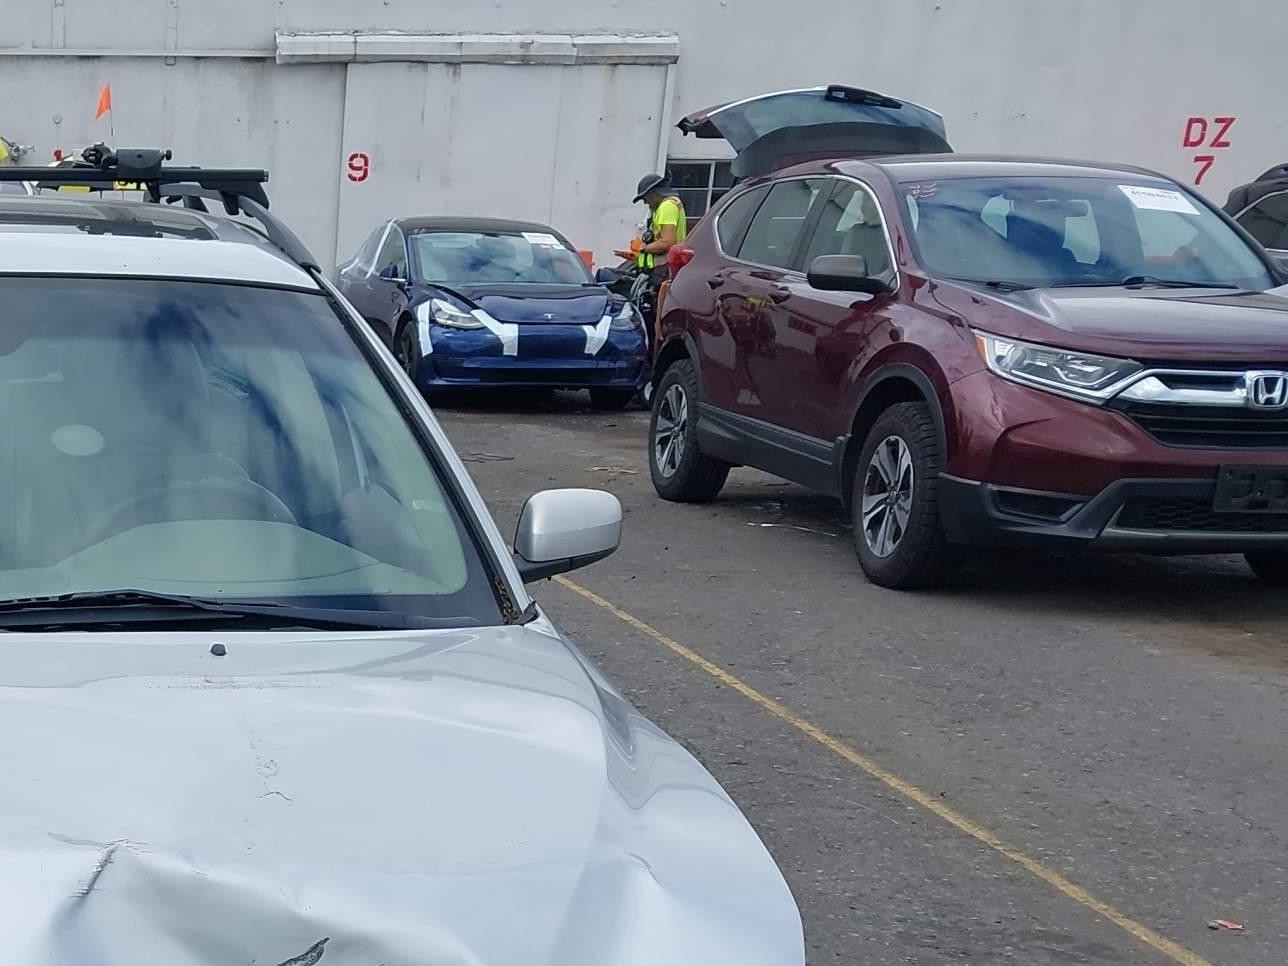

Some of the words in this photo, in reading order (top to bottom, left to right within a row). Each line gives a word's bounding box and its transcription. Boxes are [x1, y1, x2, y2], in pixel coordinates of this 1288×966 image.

[1183, 117, 1236, 148] DZ
[347, 152, 369, 182] 9
[1193, 155, 1215, 185] 7
